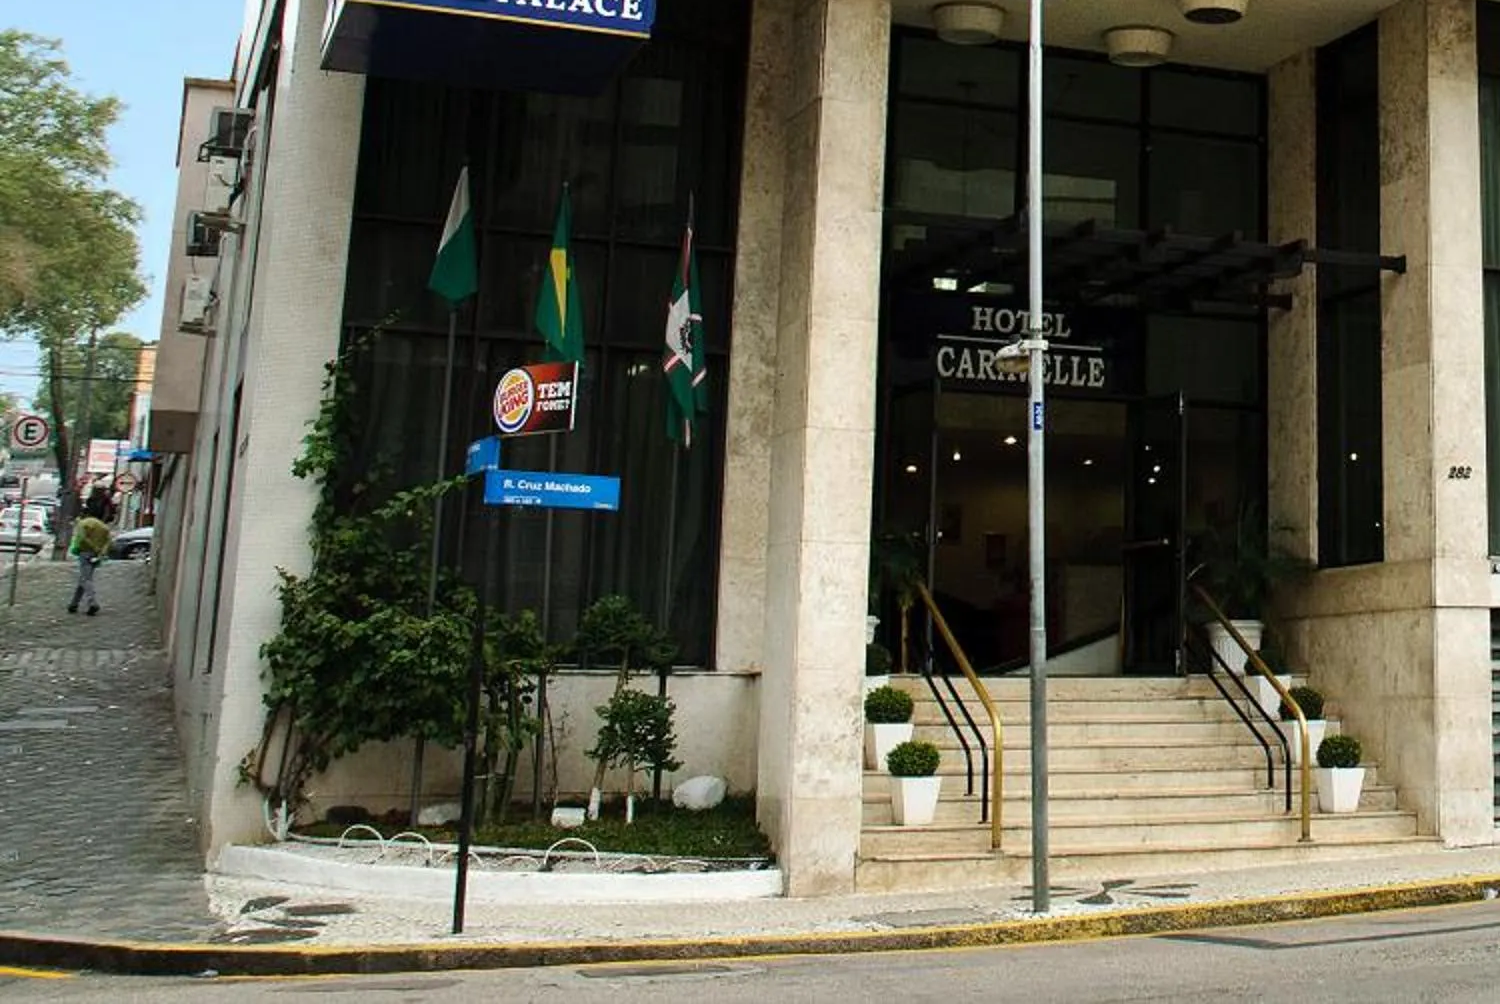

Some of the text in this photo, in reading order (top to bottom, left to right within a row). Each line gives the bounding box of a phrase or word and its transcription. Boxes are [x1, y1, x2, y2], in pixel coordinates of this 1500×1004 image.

[971, 306, 1072, 338] HOTEL
[936, 346, 1105, 387] CARELLE
[537, 381, 572, 398] TEM
[24, 422, 38, 440] E
[517, 480, 542, 491] Cruz
[544, 482, 592, 494] Machado
